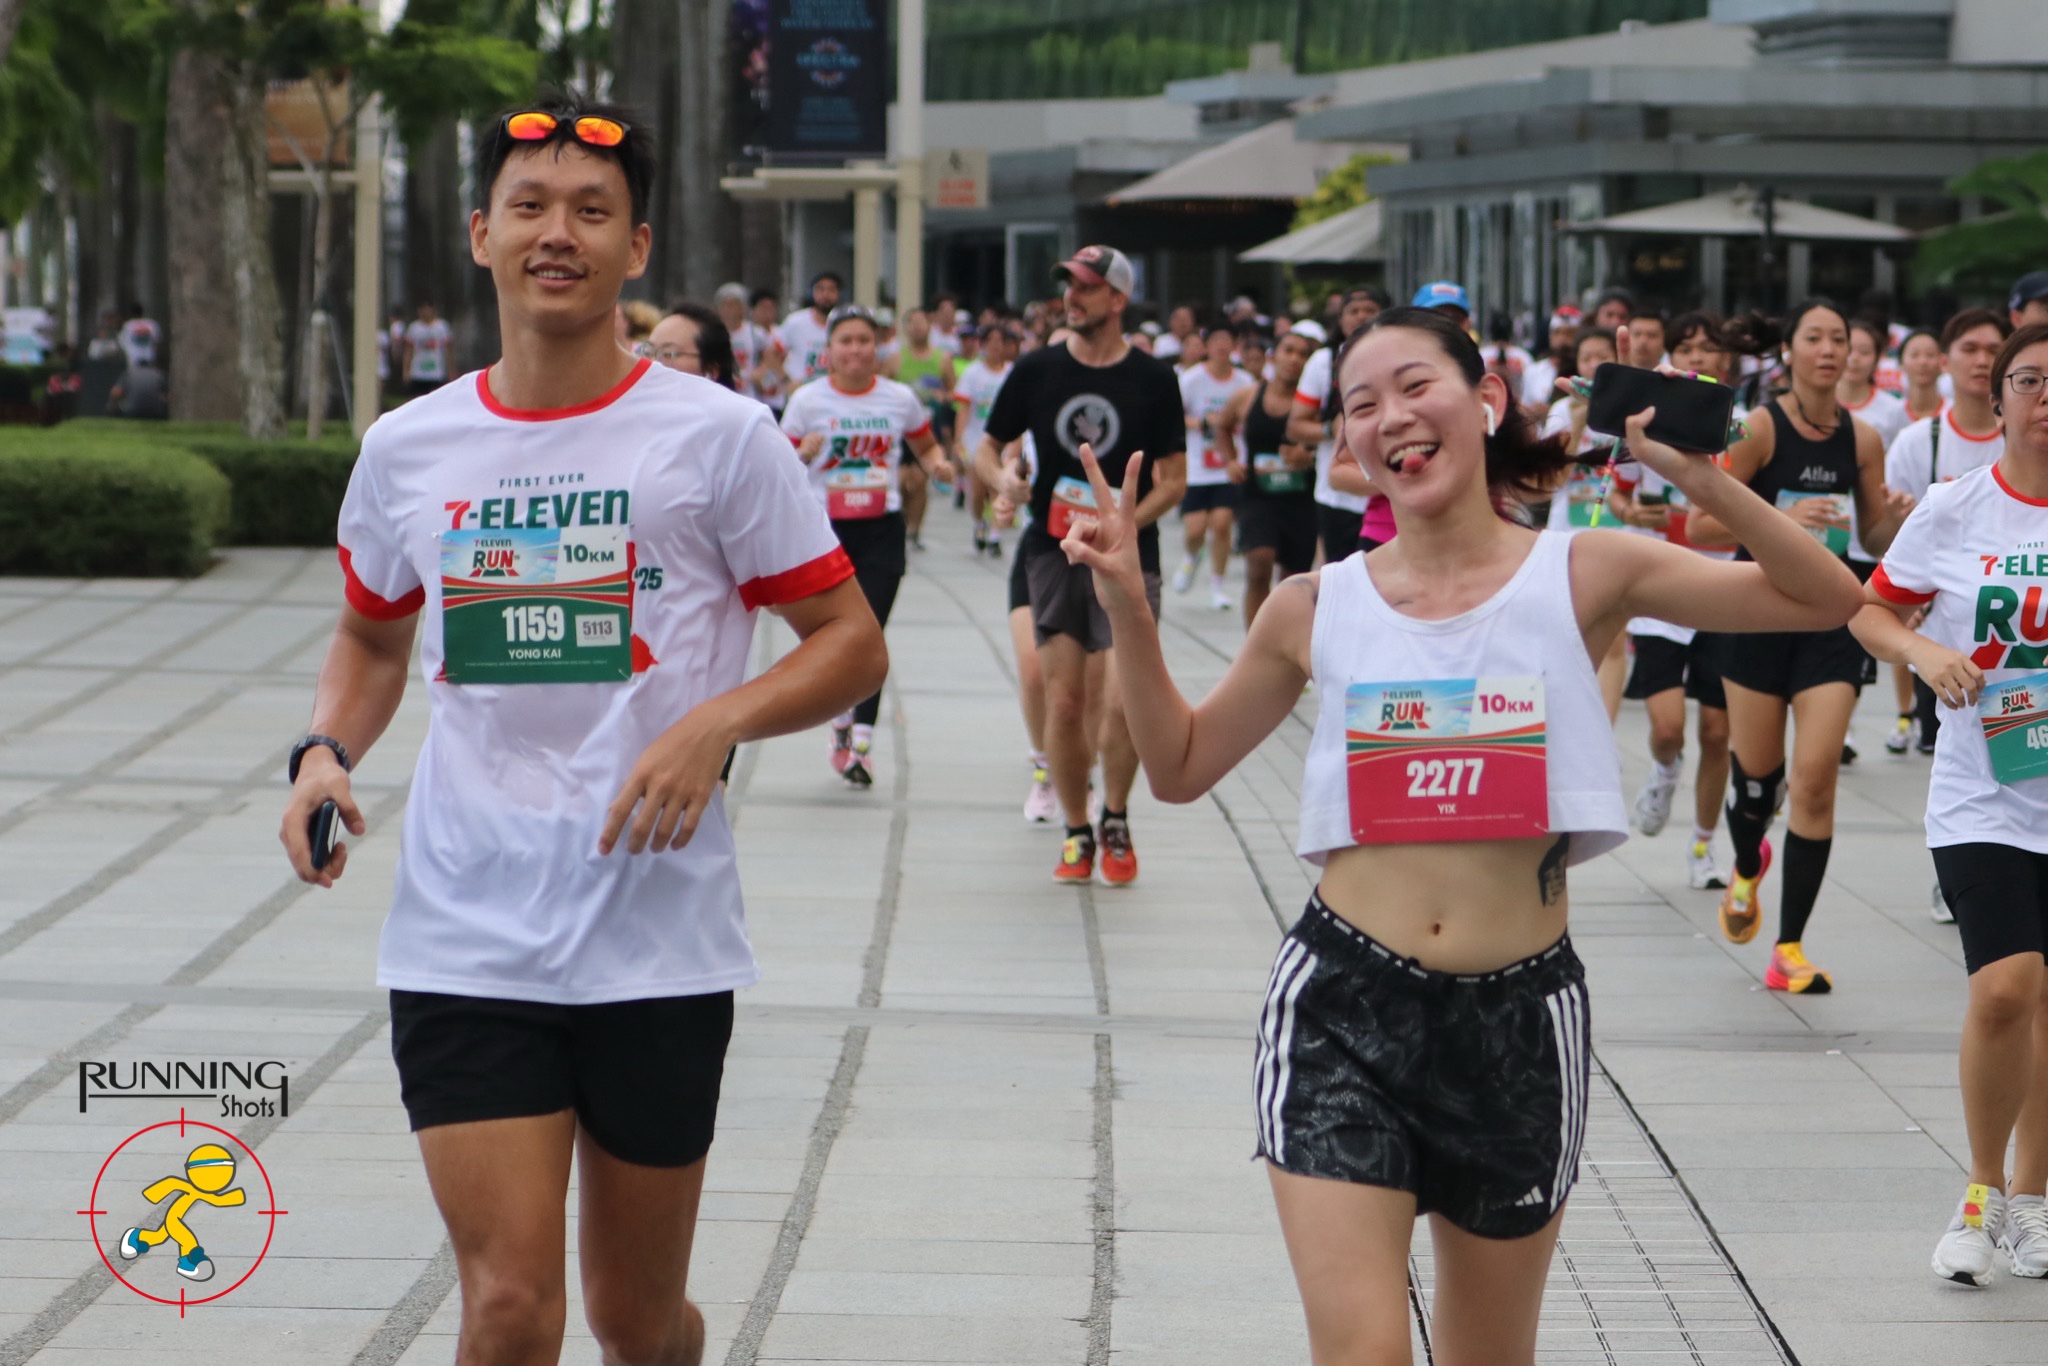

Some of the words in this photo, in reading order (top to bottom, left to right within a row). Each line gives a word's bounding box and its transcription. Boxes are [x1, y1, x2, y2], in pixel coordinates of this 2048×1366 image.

[830, 434, 893, 459] RUN
[500, 477, 541, 488] FIRST
[549, 473, 585, 485] EVER
[1799, 466, 1837, 483] Atlas
[2017, 541, 2045, 550] FIRST
[472, 550, 514, 568] RUN
[502, 605, 565, 642] 1159
[582, 620, 613, 636] 5113
[508, 649, 541, 660] YONG
[543, 648, 561, 659] KAI
[2001, 692, 2029, 708] RUN
[1381, 701, 1425, 721] RUN
[1406, 758, 1484, 798] 2277
[1437, 804, 1456, 815] YIX
